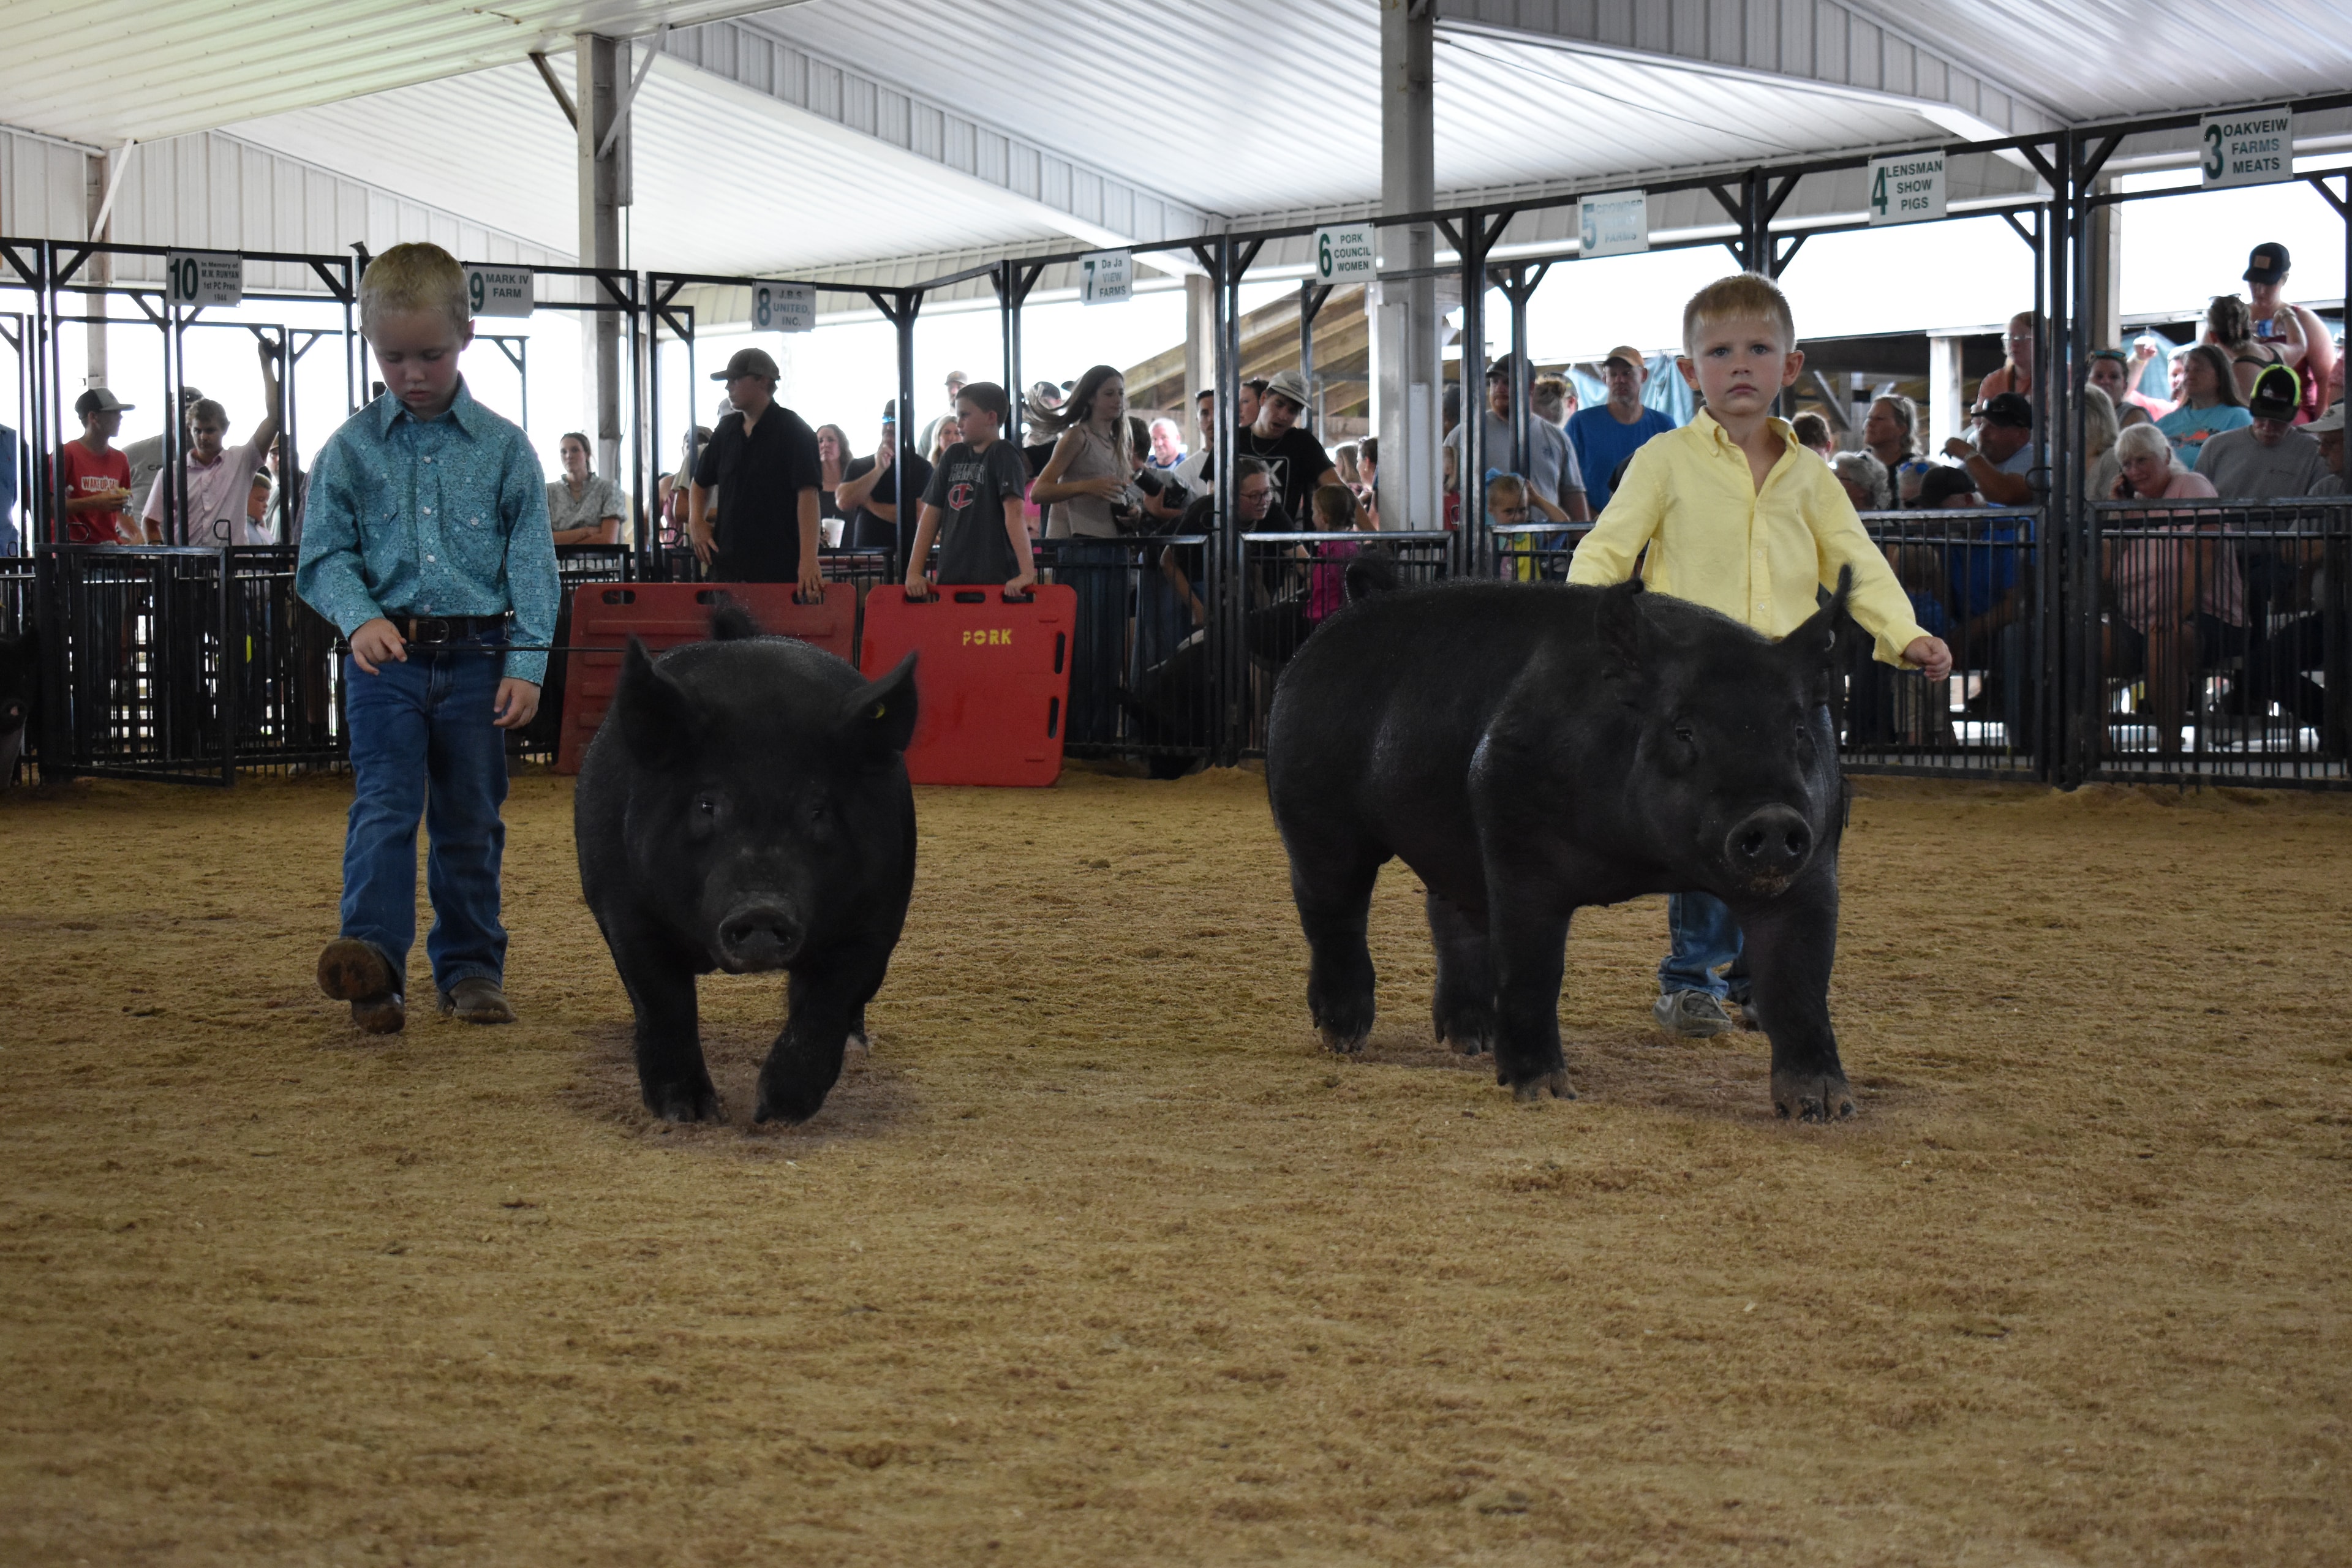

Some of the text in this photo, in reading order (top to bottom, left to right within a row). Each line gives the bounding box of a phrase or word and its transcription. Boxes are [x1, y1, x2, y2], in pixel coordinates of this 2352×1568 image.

[2223, 118, 2288, 137] OAKVEIW
[2204, 124, 2223, 180] 3
[2231, 138, 2280, 156] FARMS
[1885, 160, 1943, 178] LENSMAN
[2233, 157, 2280, 174] MEATS
[1871, 167, 1888, 216] 4
[1896, 179, 1932, 194] SHOW
[1901, 197, 1929, 211] PIGS
[1582, 203, 1597, 251] 5
[1340, 233, 1363, 244] PORK
[1318, 233, 1332, 278] 6
[1333, 247, 1371, 258] COUNCIL
[216, 270, 239, 279] RUNYAN
[1337, 260, 1369, 272] WOMEN
[169, 258, 198, 301] 10
[486, 274, 529, 285] MARK IV
[1084, 260, 1095, 301] 7
[1102, 271, 1122, 284] VIEW
[470, 272, 485, 313] 9
[493, 287, 522, 298] FARM
[1099, 285, 1126, 298] FARMS
[757, 287, 771, 326] 8
[773, 303, 810, 316] UNITED,
[782, 317, 801, 326] INC.
[962, 628, 1012, 646] PORK
